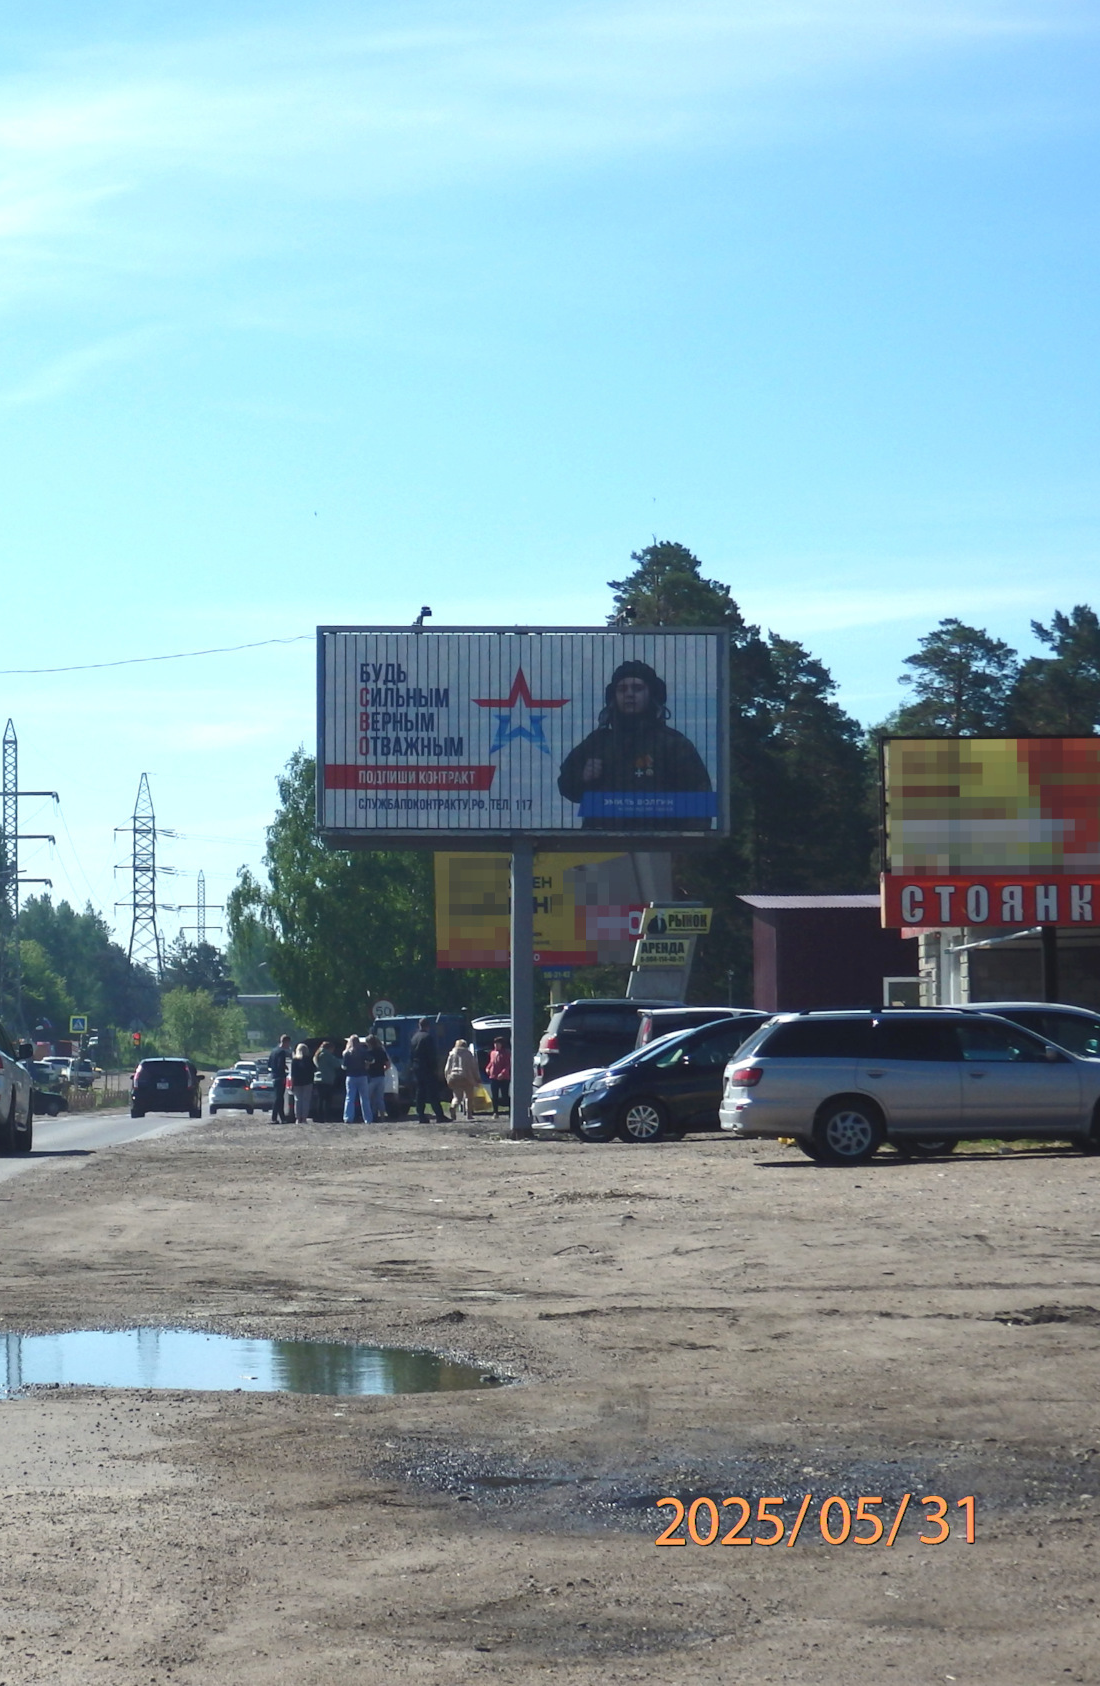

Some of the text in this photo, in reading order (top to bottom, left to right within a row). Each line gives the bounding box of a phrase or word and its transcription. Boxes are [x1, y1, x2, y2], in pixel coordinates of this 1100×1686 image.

[360, 663, 407, 685] БУДЬ
[359, 687, 449, 708] СИЛЬНЫМ
[359, 711, 435, 732] ВЕРНЫМ
[359, 736, 464, 757] ОТВАЖНЫМ
[358, 770, 476, 785] ПОДПИШИ КОНТРАКТ
[516, 799, 533, 811] 117
[901, 884, 1094, 924] СТОЯНК
[668, 914, 708, 928] РЫНОК
[641, 942, 685, 955] АРЕНДА
[375, 1006, 392, 1016] 50
